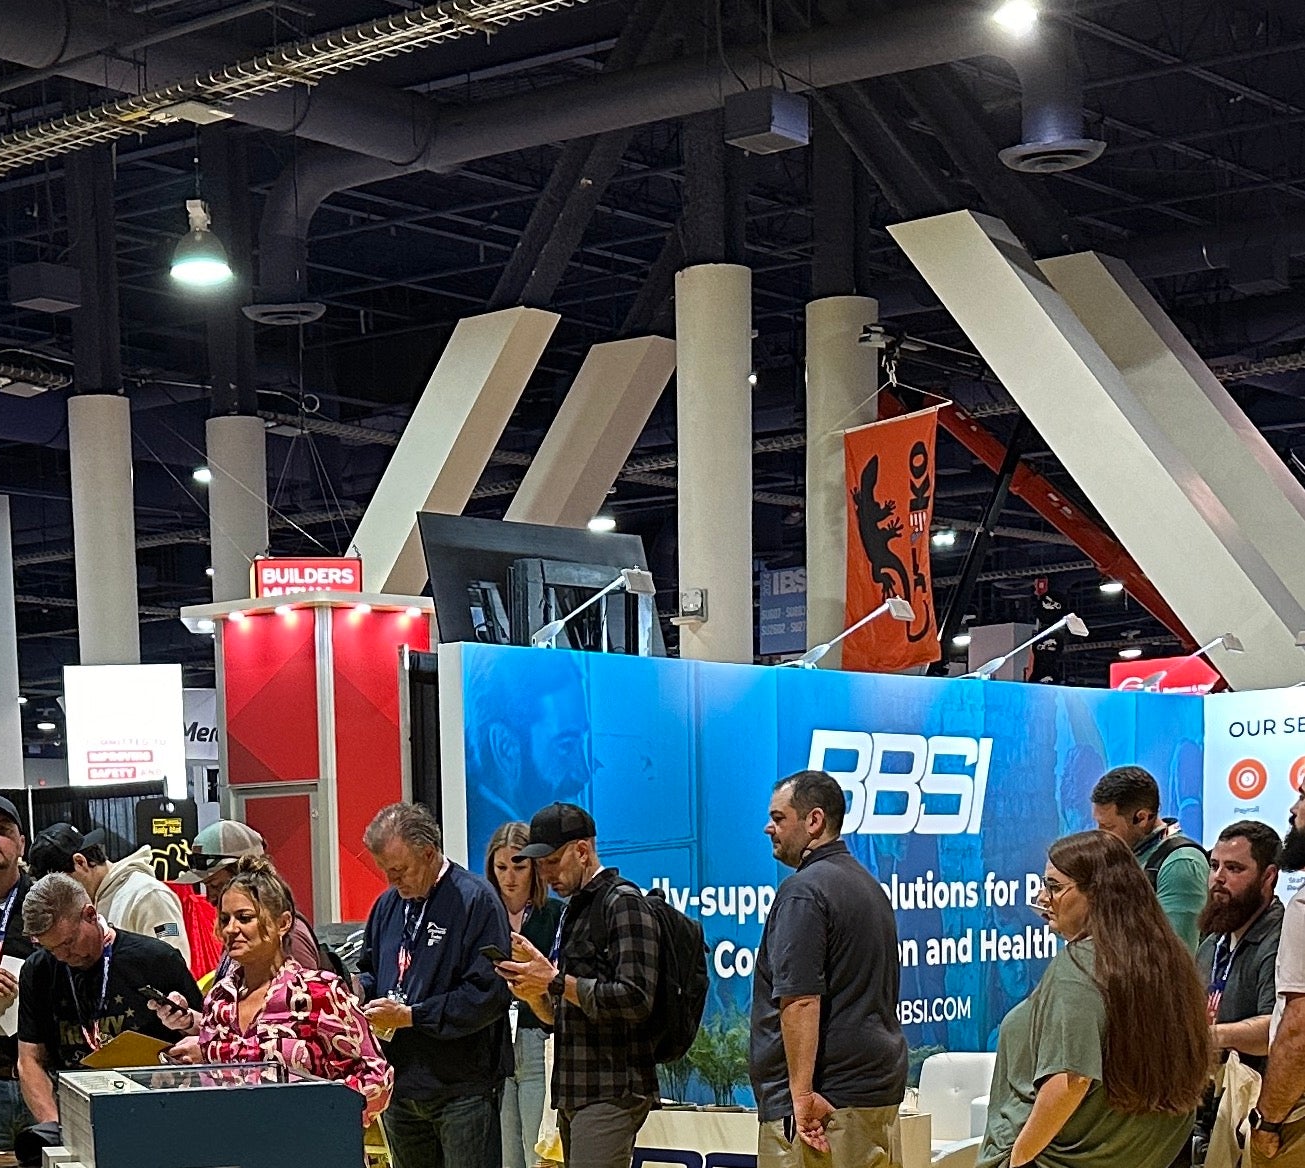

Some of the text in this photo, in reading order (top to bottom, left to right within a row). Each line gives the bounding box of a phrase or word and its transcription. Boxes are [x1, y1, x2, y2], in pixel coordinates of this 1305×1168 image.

[262, 568, 354, 585] BUILDERS
[1229, 719, 1276, 738] OUR
[808, 729, 993, 835] BBSI
[984, 871, 1020, 908] for
[714, 939, 760, 979] Co
[926, 928, 973, 966] and
[980, 924, 1058, 962] Health
